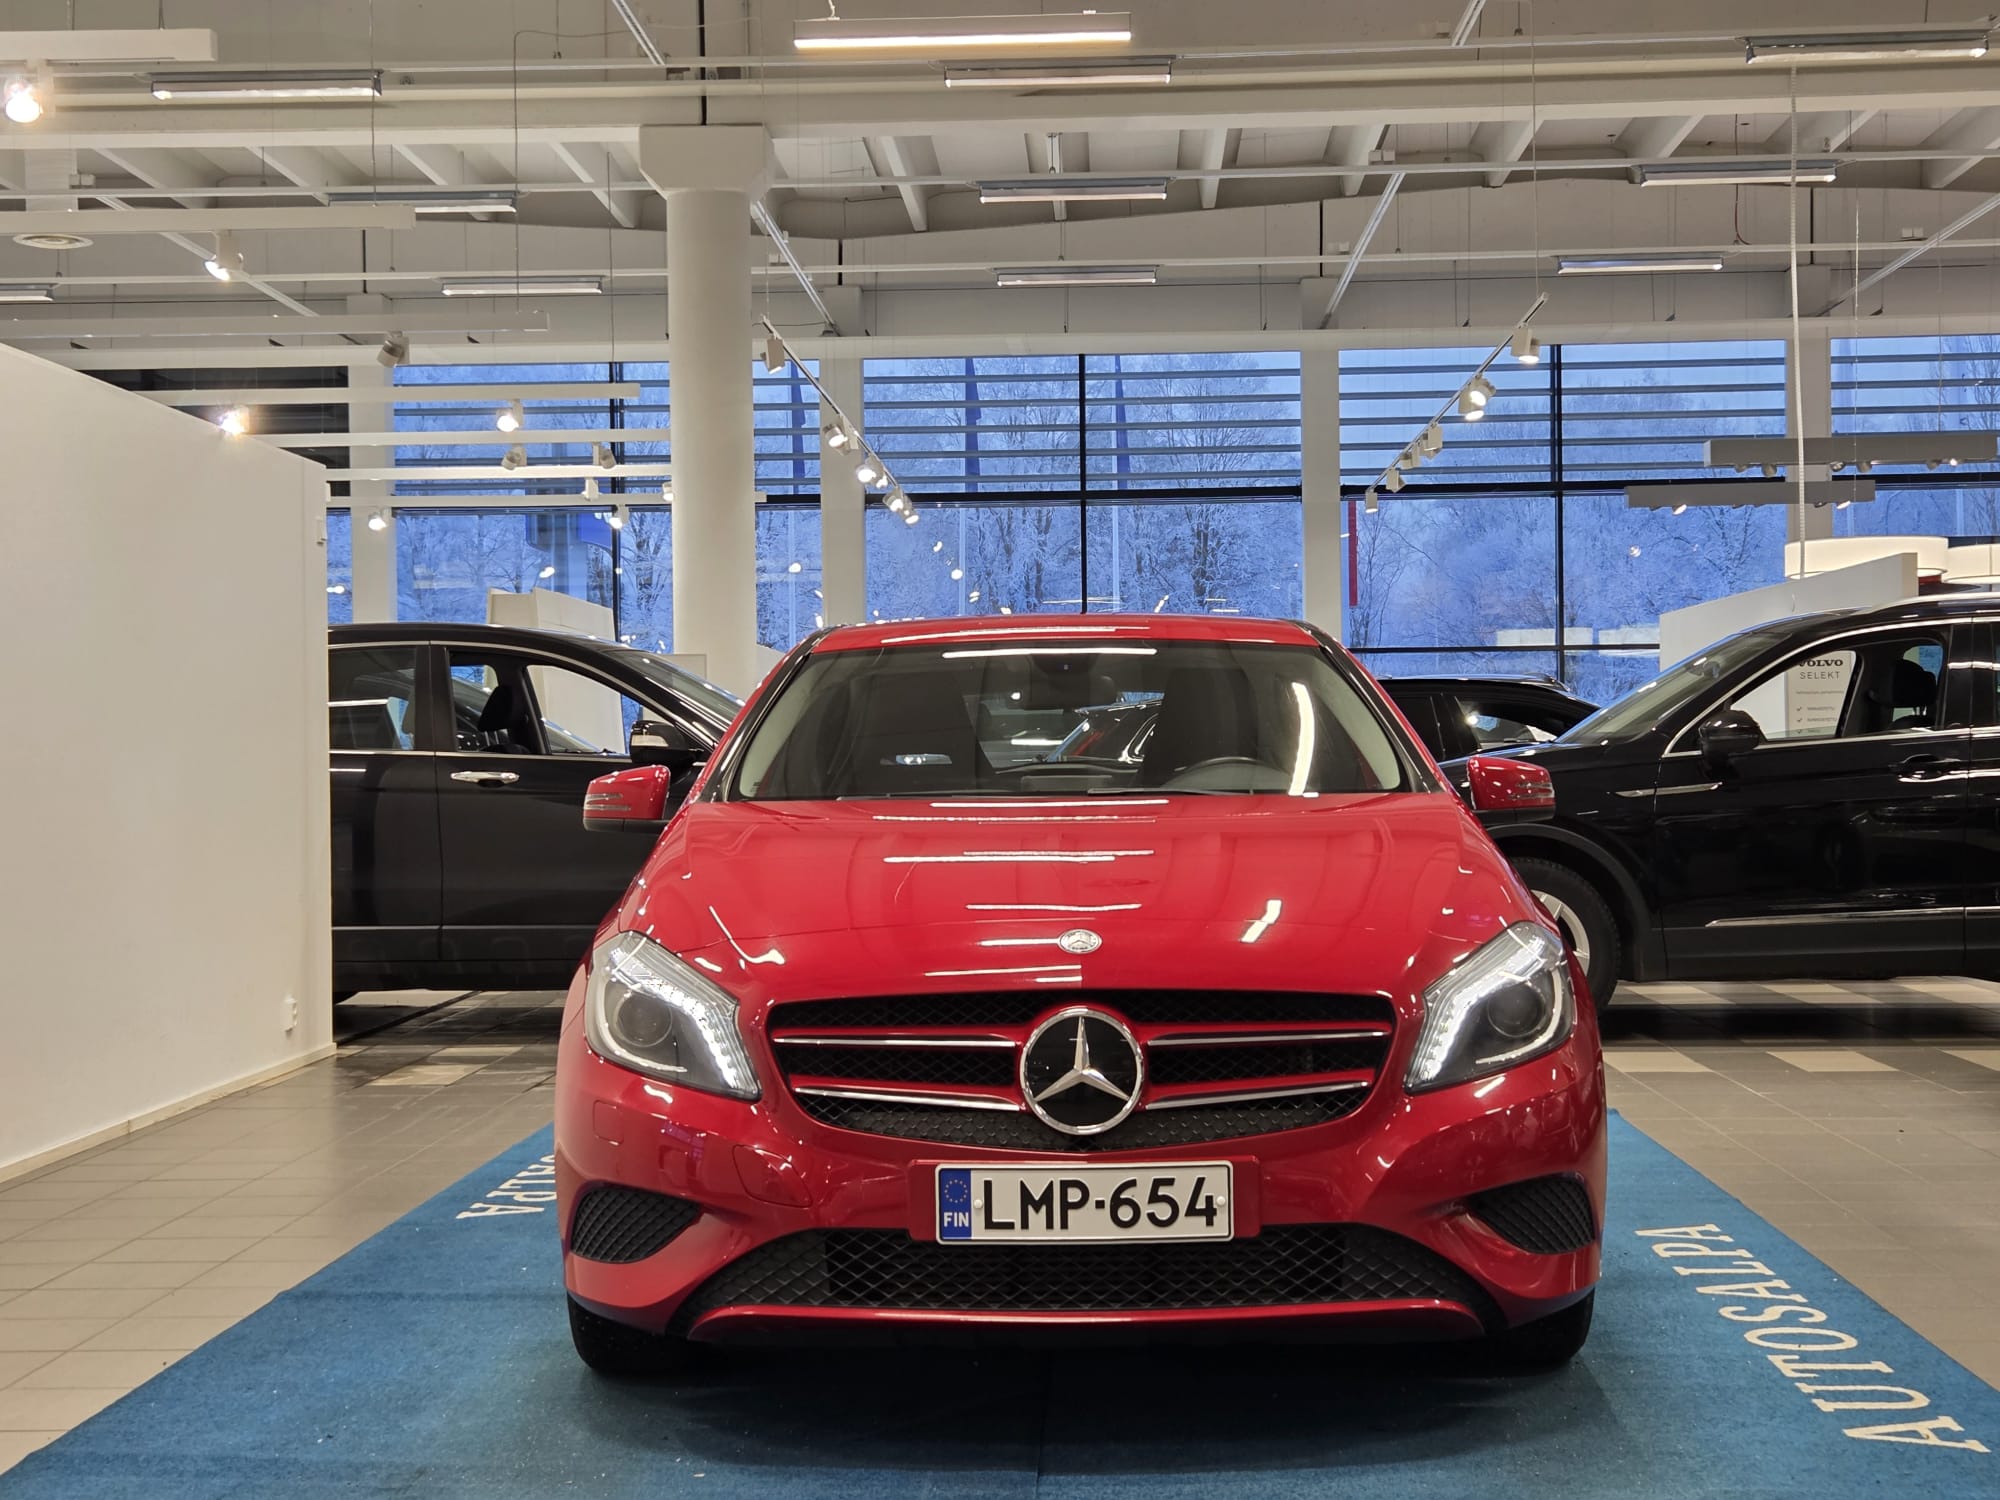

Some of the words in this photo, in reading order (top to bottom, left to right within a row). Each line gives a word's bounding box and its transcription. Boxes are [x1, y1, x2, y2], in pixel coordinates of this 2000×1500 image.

[1799, 671, 1841, 680] SELEKT
[943, 1211, 969, 1228] FIN
[983, 1176, 1218, 1230] LMP-654
[1634, 1223, 1992, 1453] AUTOSALPA
